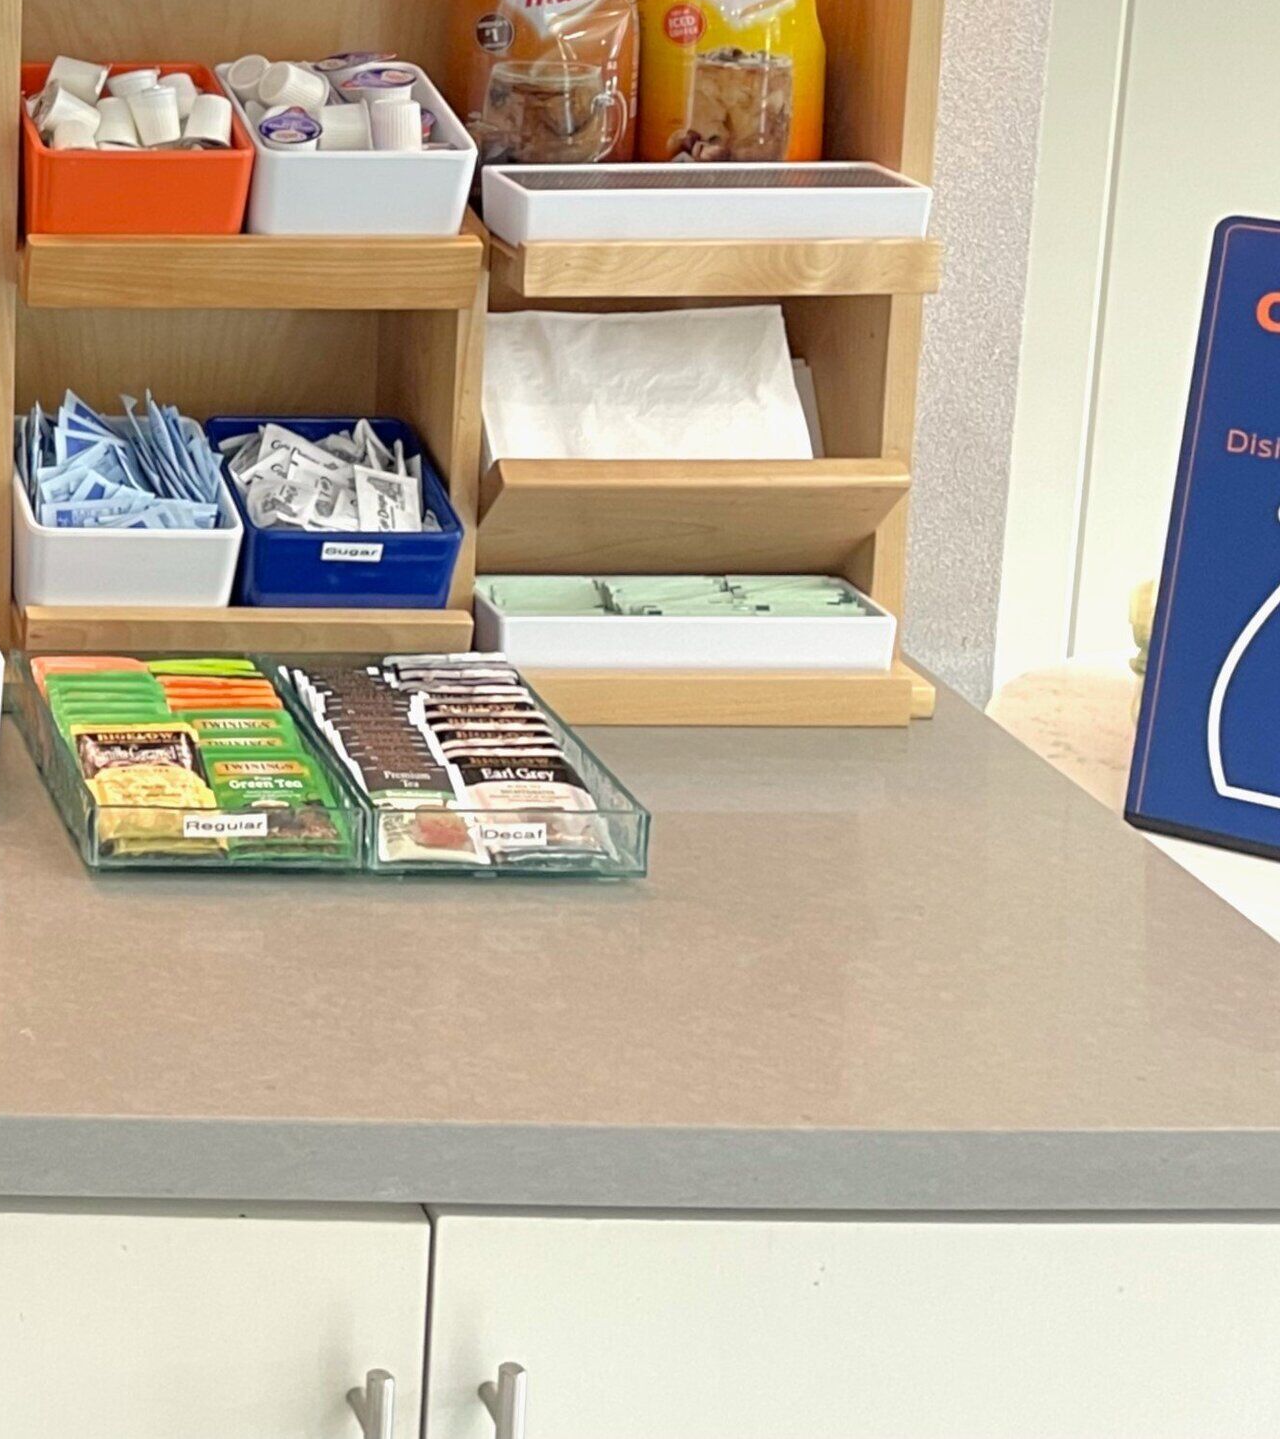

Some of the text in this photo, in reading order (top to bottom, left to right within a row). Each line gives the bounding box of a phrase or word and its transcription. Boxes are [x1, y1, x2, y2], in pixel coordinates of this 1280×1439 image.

[324, 547, 379, 557] Sugar
[202, 721, 271, 729] TWININGS
[97, 733, 173, 741] BIGELOW
[383, 771, 431, 780] Premium
[481, 768, 554, 781] Earl Grey
[229, 779, 303, 789] Green Tea
[401, 779, 419, 788] Tea
[186, 820, 263, 832] Regular
[484, 829, 543, 840] Decaf
